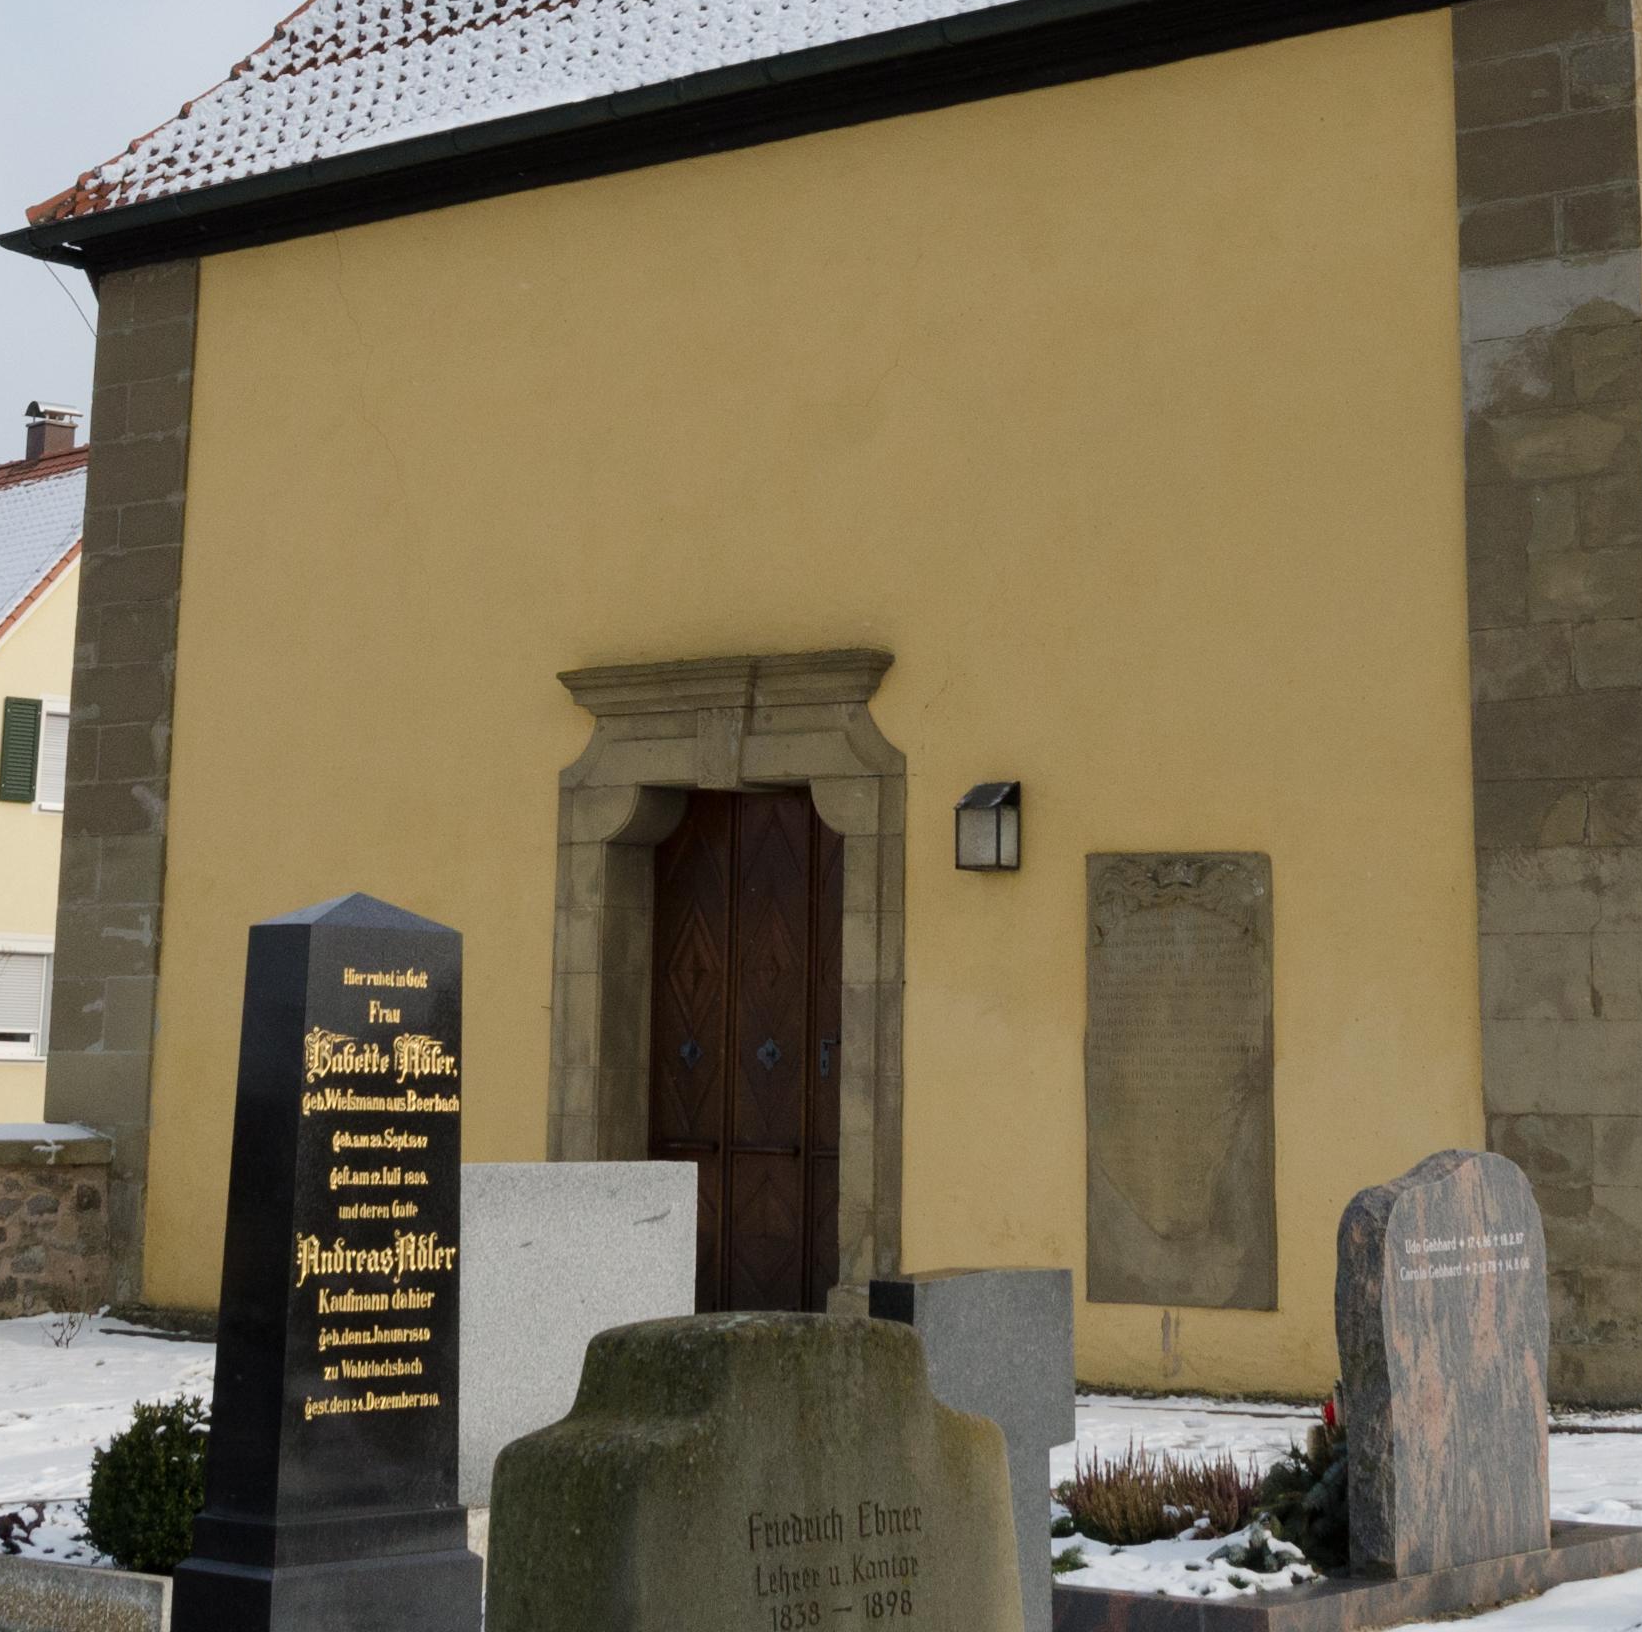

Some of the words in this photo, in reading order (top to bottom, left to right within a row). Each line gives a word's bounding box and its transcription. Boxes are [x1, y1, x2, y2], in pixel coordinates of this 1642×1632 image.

[343, 968, 367, 985] Hier
[396, 970, 405, 988] in
[406, 968, 428, 989] Gott
[368, 999, 401, 1024] Frau
[304, 1026, 390, 1083] Babette
[302, 1092, 325, 1116] geb.
[386, 1095, 406, 1112] aus
[406, 1089, 460, 1112] Beerbach
[353, 1134, 370, 1148] am
[352, 1171, 369, 1185] am
[338, 1202, 358, 1219] und
[359, 1202, 390, 1219] deren
[391, 1199, 419, 1218] Gatte
[295, 1231, 393, 1288] Andreas
[393, 1229, 456, 1284] Adler
[318, 1287, 389, 1314] Kaufmann
[391, 1287, 436, 1310] dahier
[341, 1328, 363, 1345] den
[371, 1325, 409, 1345] Januar
[323, 1365, 339, 1381] zu
[329, 1396, 351, 1414] den
[366, 1391, 420, 1411] Dezember
[748, 1506, 843, 1552] Friedrich
[858, 1500, 922, 1537] Ebner
[757, 1563, 820, 1597] Lehrer
[852, 1552, 919, 1585] Kantor
[770, 1601, 821, 1632] 1838
[863, 1590, 913, 1618] 1898
